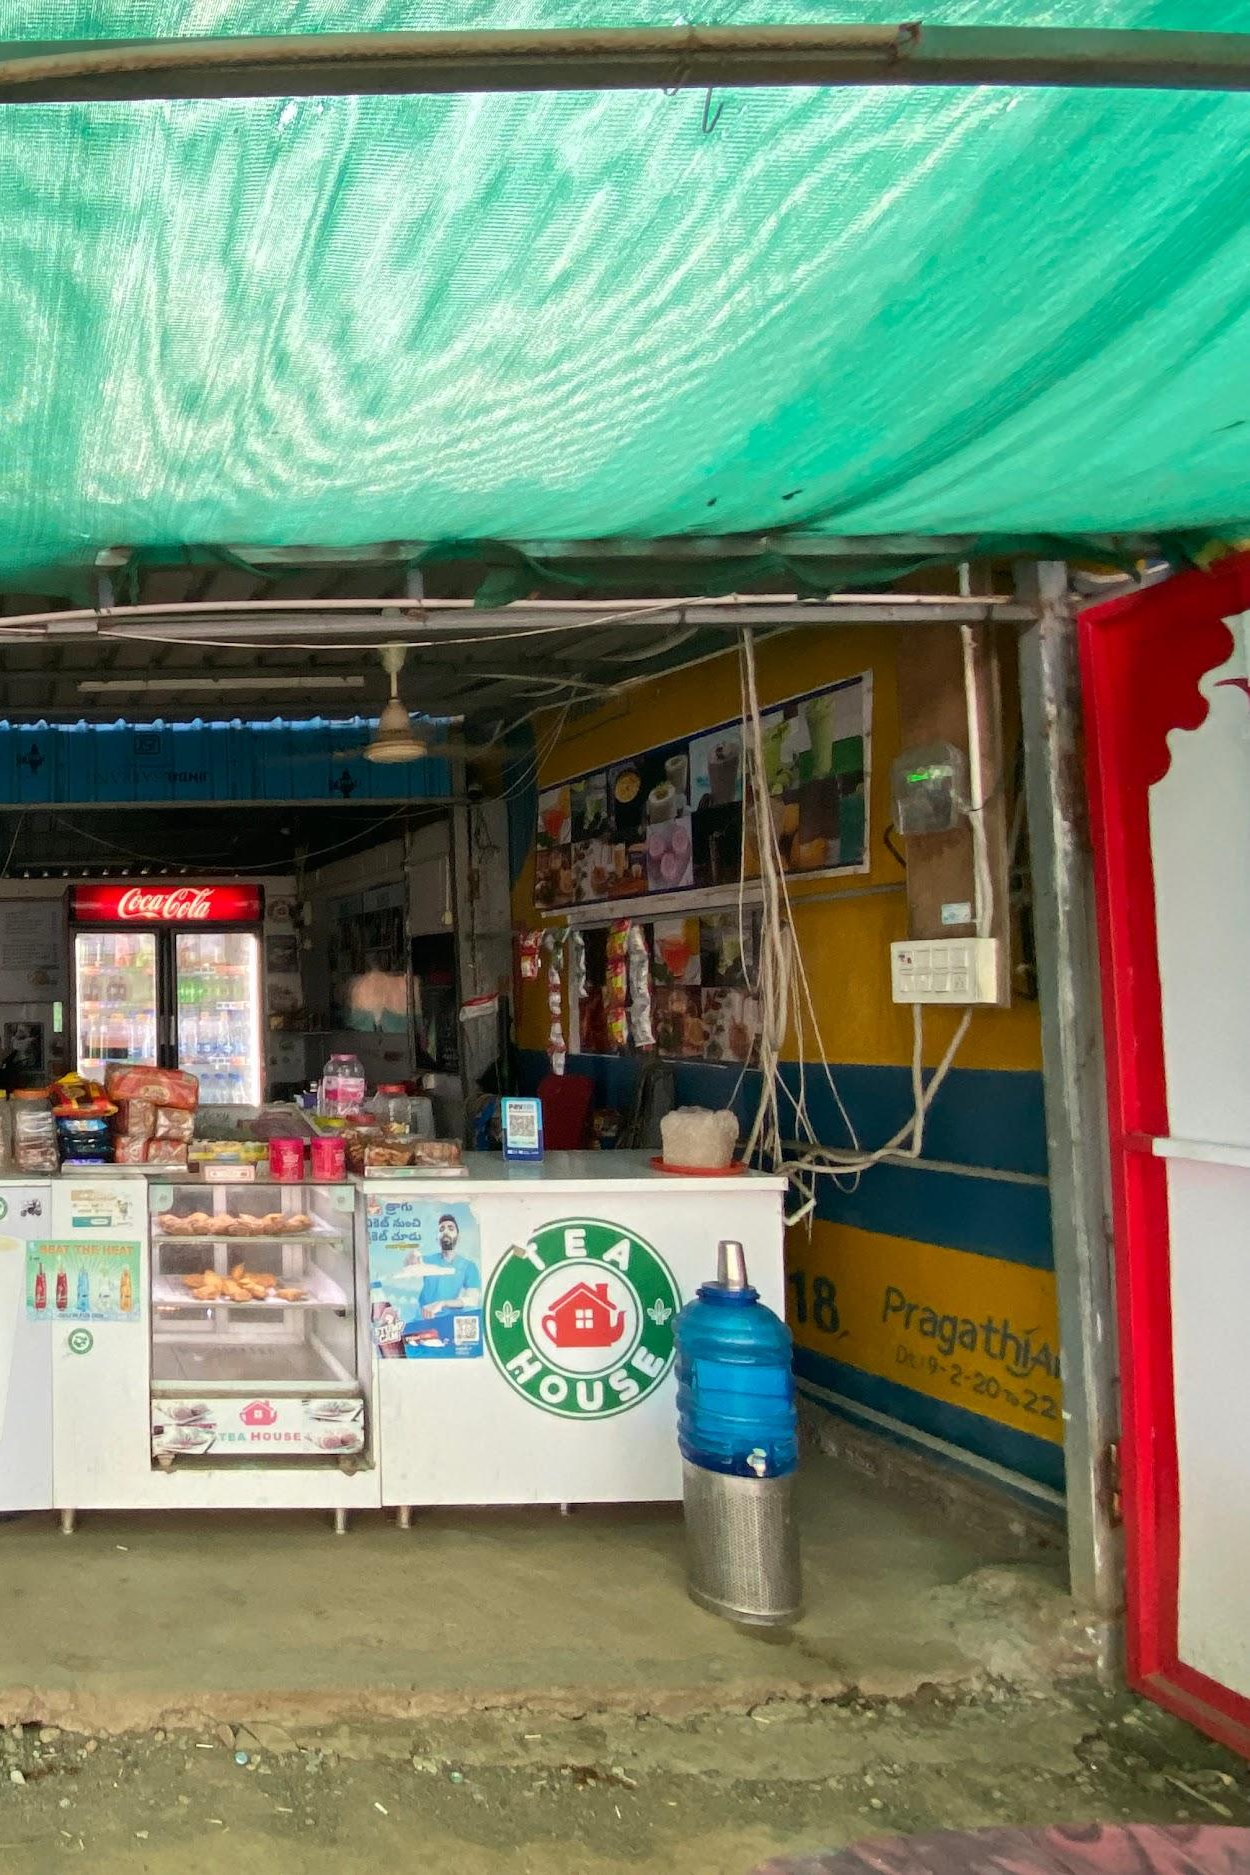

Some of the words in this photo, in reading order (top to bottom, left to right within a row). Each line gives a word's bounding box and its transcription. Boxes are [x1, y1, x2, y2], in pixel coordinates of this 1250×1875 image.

[117, 888, 215, 919] Coca-Cola
[75, 1244, 100, 1255] THE
[104, 1244, 134, 1256] HEAT
[526, 1228, 630, 1272] TEA
[506, 1346, 665, 1411] HOUSE
[220, 1432, 246, 1442] TEA
[251, 1432, 301, 1442] HOUSE
